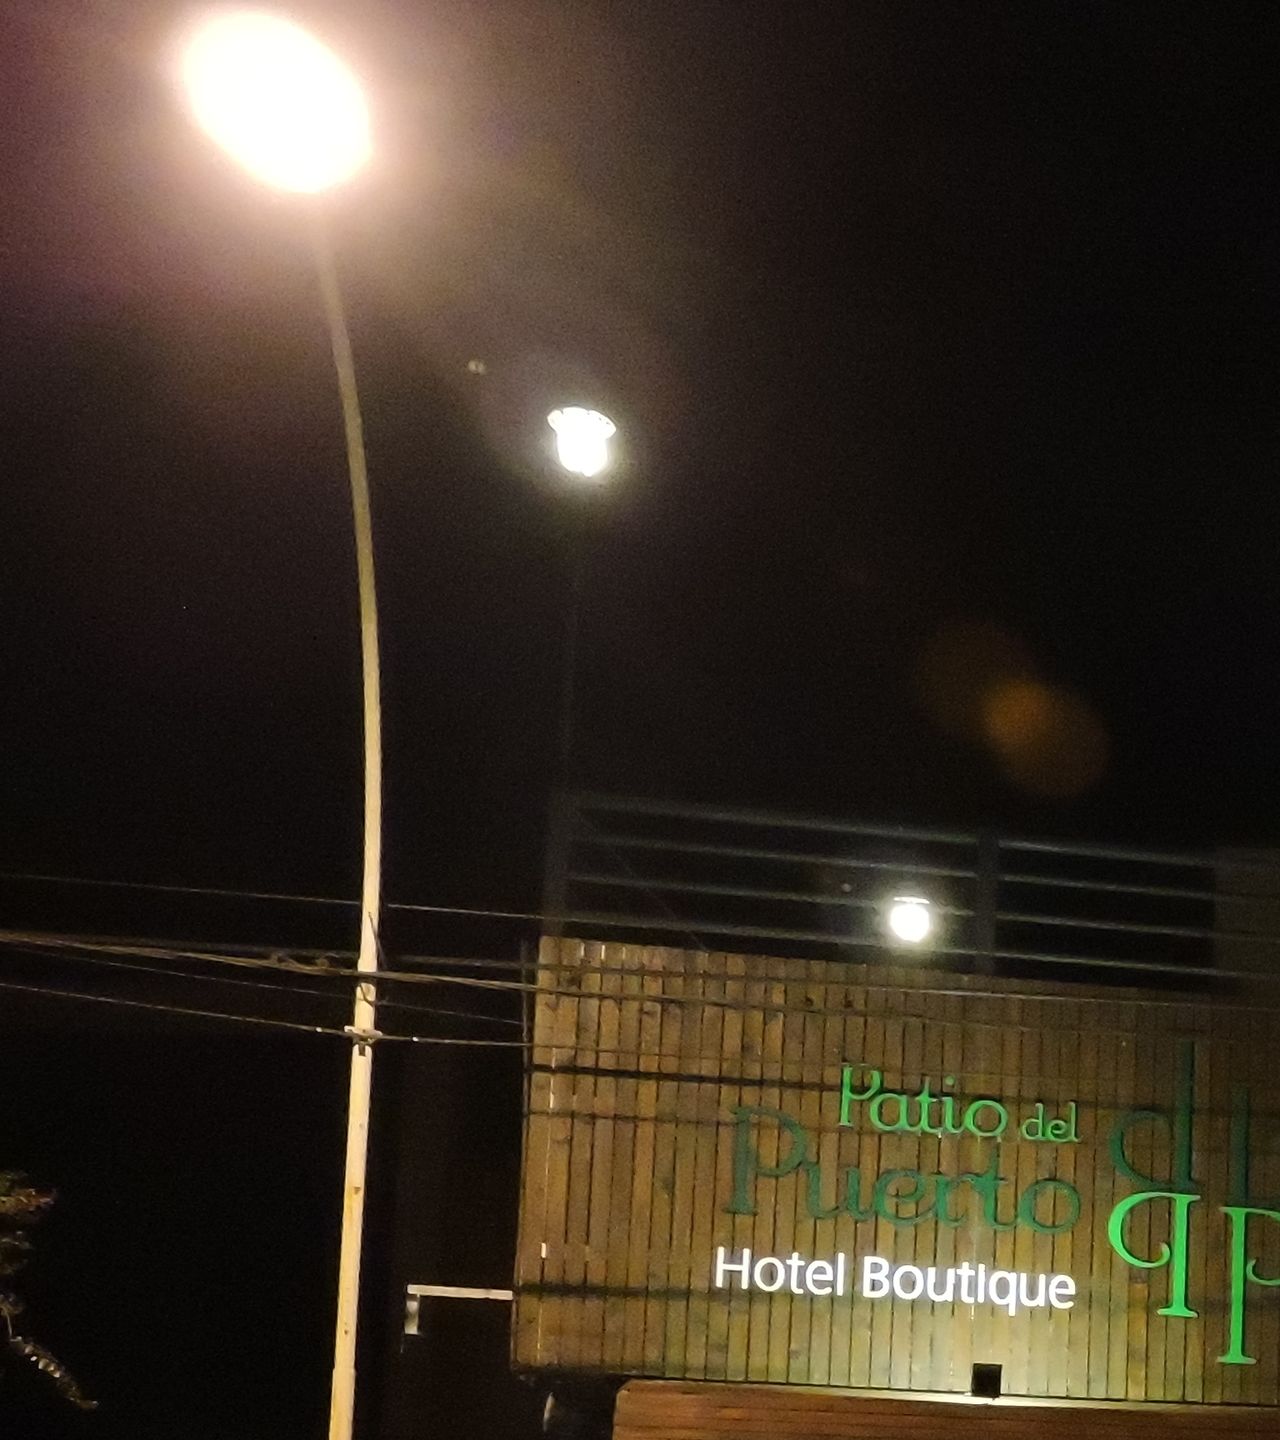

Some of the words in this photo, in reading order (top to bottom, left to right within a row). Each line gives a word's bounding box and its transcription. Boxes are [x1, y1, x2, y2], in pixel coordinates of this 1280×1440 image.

[838, 1062, 1009, 1138] Patio
[1021, 1100, 1082, 1143] del
[723, 1103, 1082, 1233] Puerto
[715, 1246, 846, 1297] Hotel
[862, 1255, 1076, 1317] Boutique
